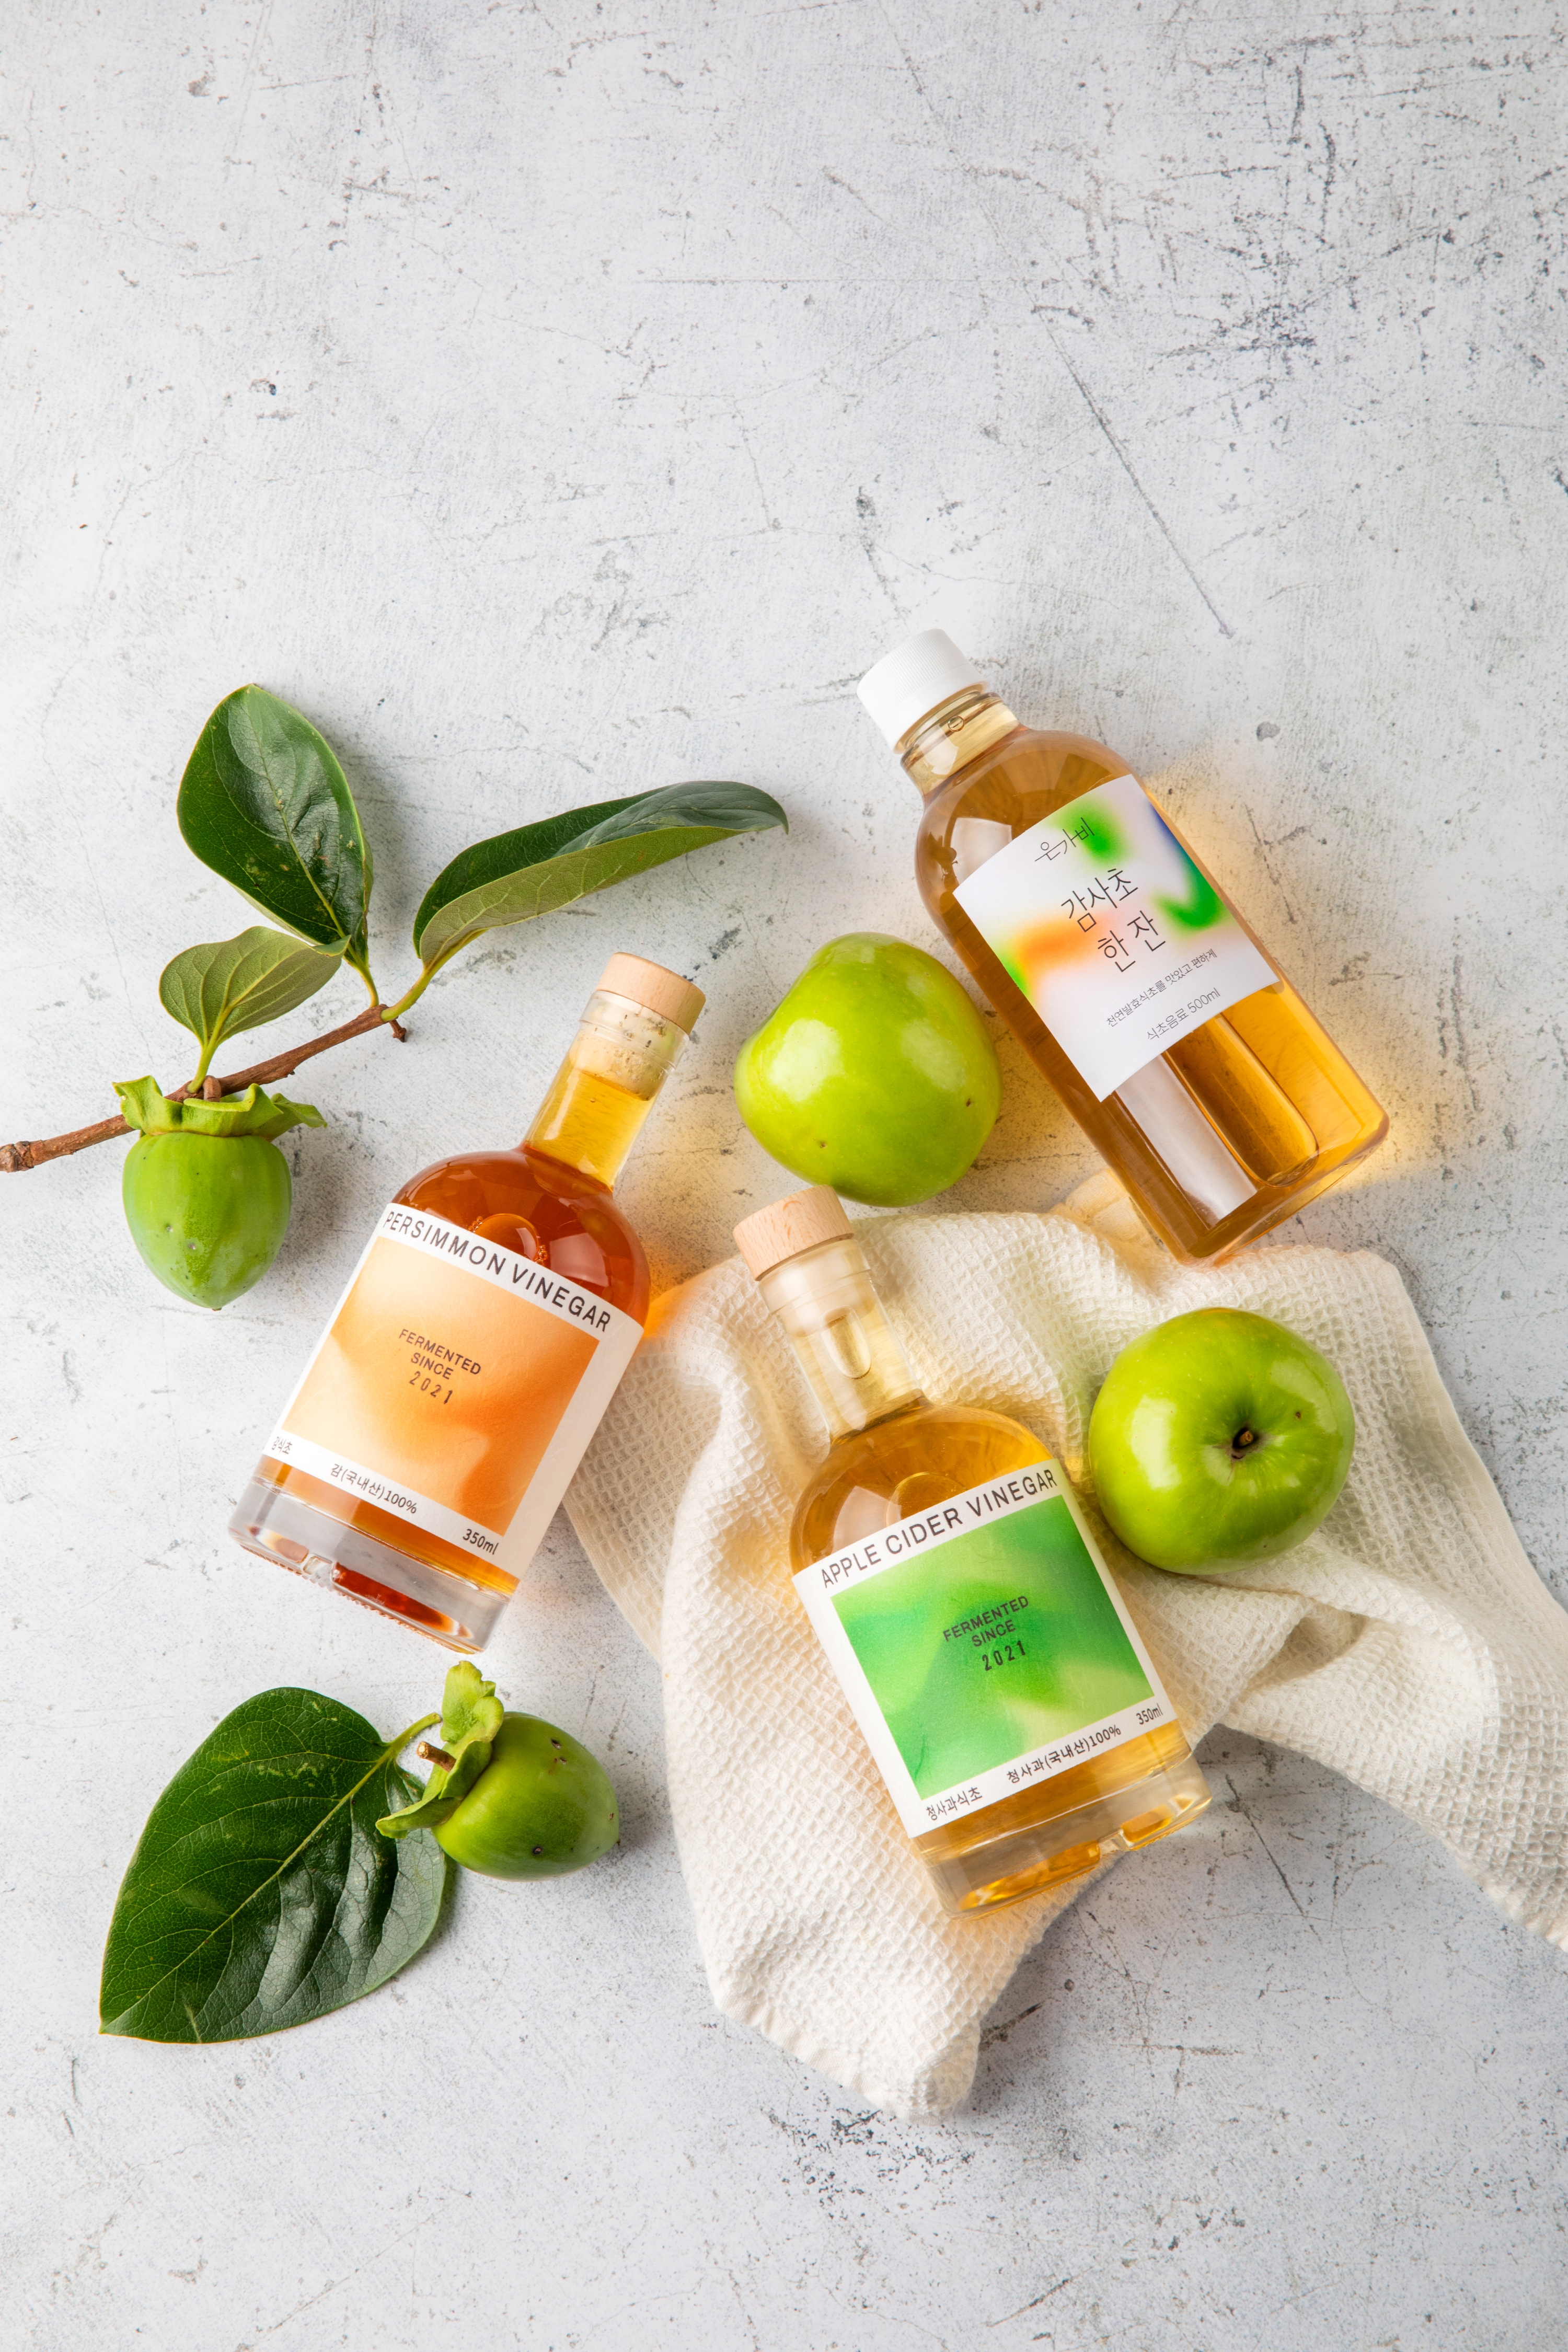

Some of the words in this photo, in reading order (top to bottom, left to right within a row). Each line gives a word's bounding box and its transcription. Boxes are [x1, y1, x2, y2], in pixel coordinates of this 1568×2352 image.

[1060, 868, 1138, 933] 감사초
[1098, 930, 1136, 973] 한
[1127, 910, 1166, 952] 잔
[1106, 980, 1167, 1027] 천연발효식초를
[1165, 964, 1193, 985] 맛있고
[1191, 948, 1217, 968] 편하게
[1147, 1008, 1189, 1040] 식초음료
[1187, 987, 1221, 1013] 500ml
[383, 1210, 507, 1275] PERSIMMON
[511, 1262, 612, 1333] VINEGAR
[398, 1328, 481, 1376] FERMENTED
[410, 1352, 454, 1380] SINCE
[409, 1370, 454, 1405] 2021
[271, 1436, 293, 1455] 감식초
[330, 1463, 417, 1514] 감(국내산)100%
[462, 1528, 499, 1555] 350ml
[820, 1543, 882, 1589] APPLE
[885, 1507, 963, 1555] CIDER
[966, 1469, 1058, 1518] VINEGAR
[942, 1595, 1030, 1643] FERMENTED
[971, 1619, 1017, 1648] SINCE
[981, 1640, 1027, 1673] 2021
[926, 1786, 983, 1821] 청사과식초
[1006, 1724, 1121, 1784] 청사과(국내산)100%
[1136, 1702, 1163, 1725] 350ml
